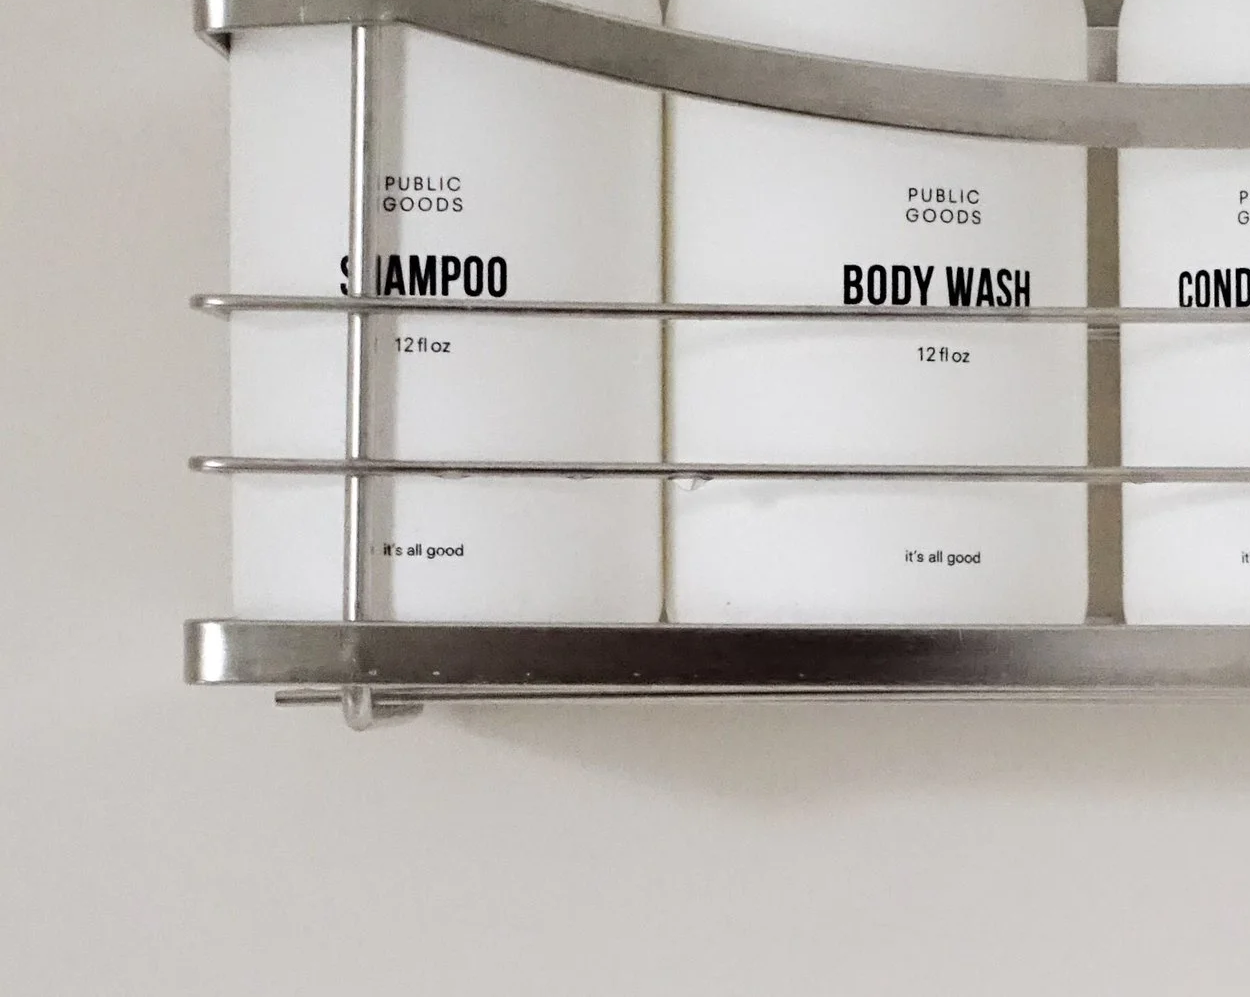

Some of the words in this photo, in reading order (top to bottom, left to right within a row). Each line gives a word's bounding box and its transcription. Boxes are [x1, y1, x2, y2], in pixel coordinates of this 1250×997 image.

[385, 176, 462, 192] PUBLIC
[382, 197, 464, 212] GOODS
[907, 187, 980, 205] PUBLIC
[905, 208, 982, 225] GOODS
[339, 255, 508, 298] SAMPOO
[843, 264, 934, 306] BODY
[945, 266, 1030, 307] WASH
[383, 543, 403, 556] it's
[407, 543, 422, 556] all
[426, 543, 464, 559] good
[905, 549, 924, 563] it's
[928, 550, 943, 563] all
[946, 551, 981, 566] good
